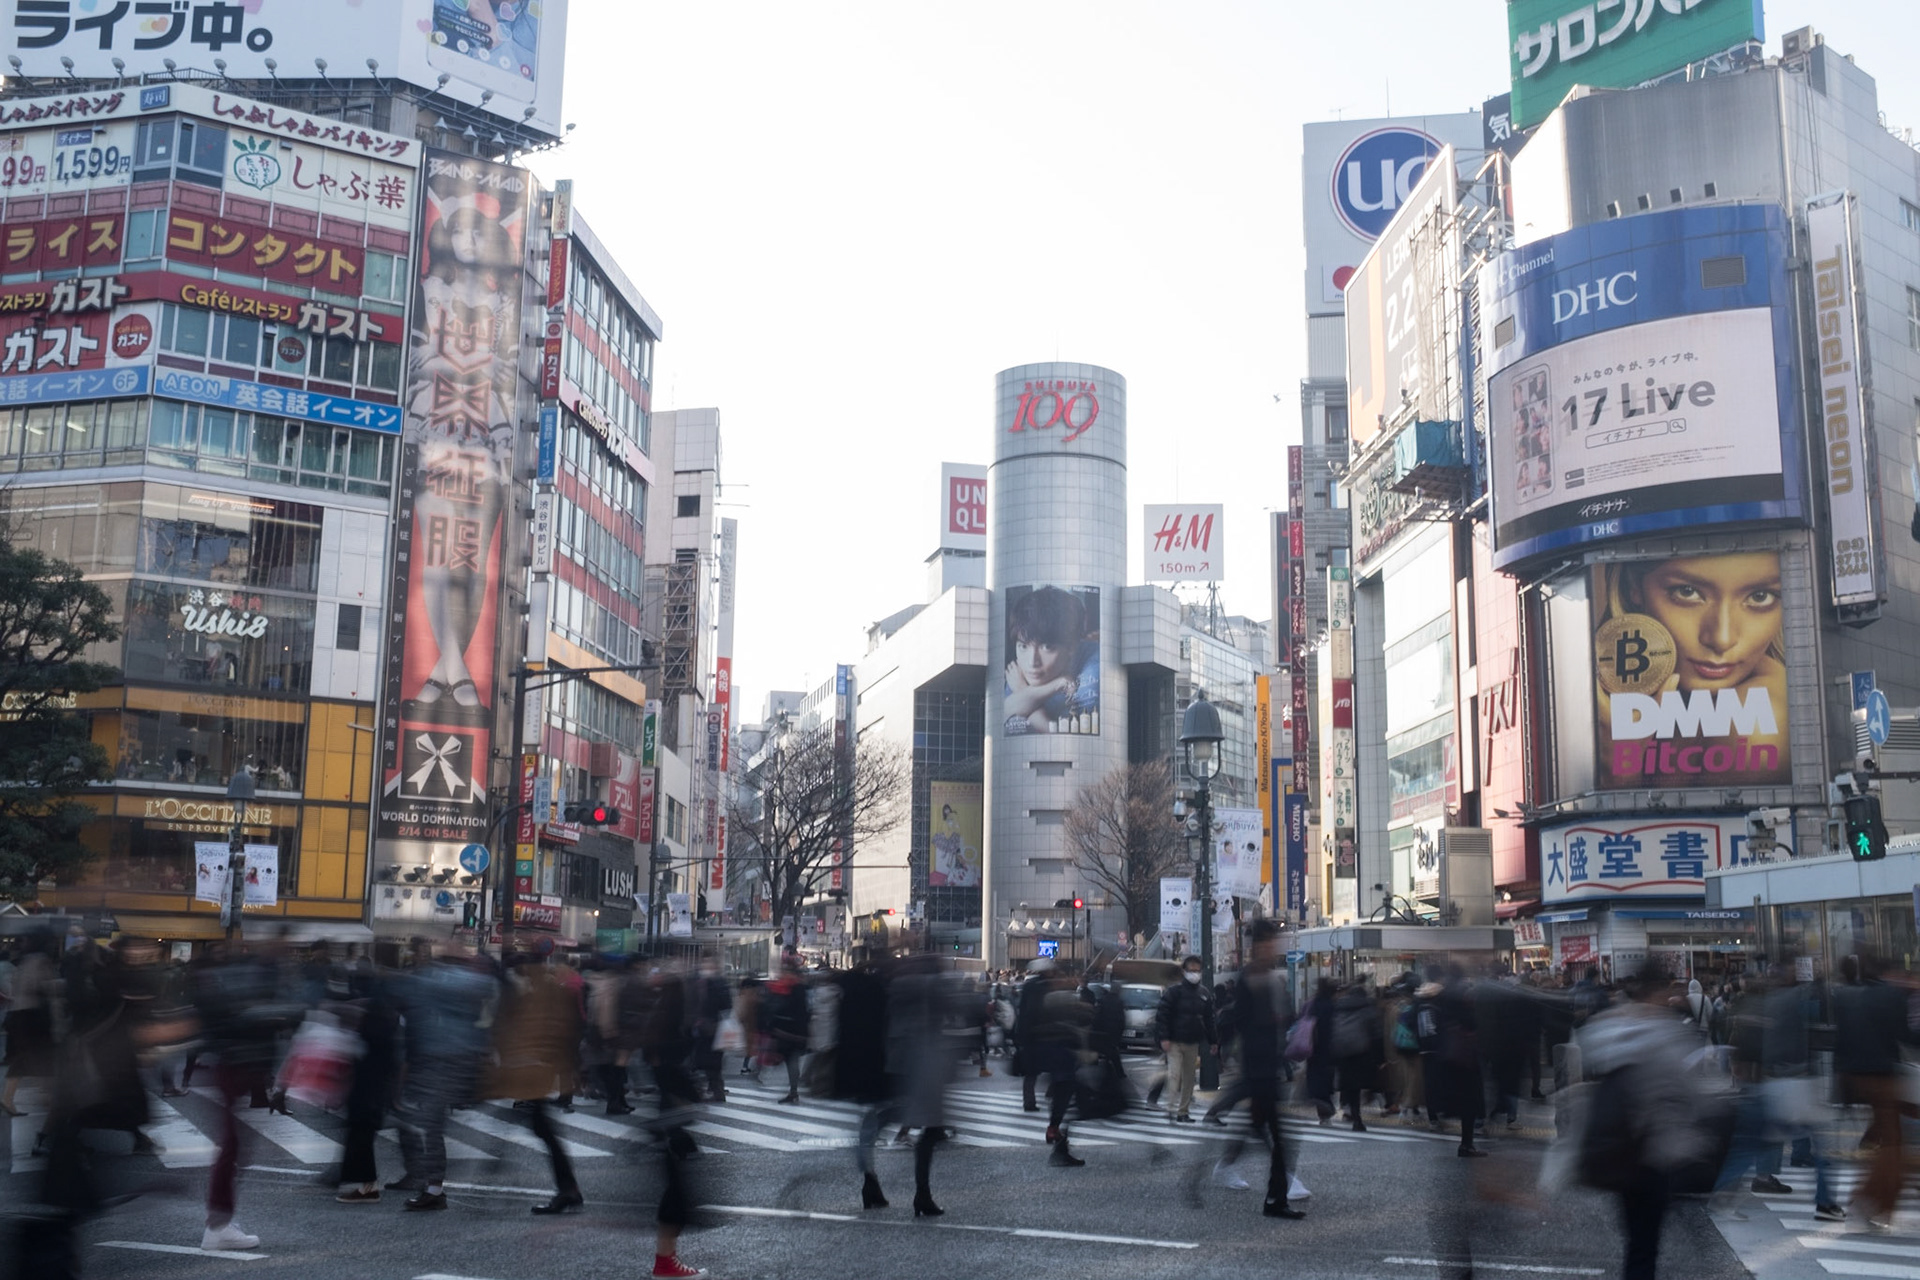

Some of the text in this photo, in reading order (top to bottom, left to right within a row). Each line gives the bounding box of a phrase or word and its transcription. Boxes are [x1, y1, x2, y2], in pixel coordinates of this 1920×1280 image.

[14, 0, 273, 52] ライブ中。
[1514, 0, 1702, 78] サロン
[143, 90, 167, 105] 寿司
[60, 133, 91, 145] ディナー
[213, 94, 411, 158] しゃぶしゃぶバイキング
[292, 154, 407, 211] しゃぶ葉
[428, 157, 526, 194] BAND-MAID
[168, 216, 358, 284] コンタクト
[1508, 247, 1555, 282] Channel
[49, 276, 128, 314] ガスト
[1551, 269, 1639, 326] DHC
[117, 332, 149, 348] ガスト
[297, 302, 384, 343] ガスト
[1, 326, 99, 373] ガスト
[115, 373, 136, 394] 6F
[546, 355, 558, 391] ガスト
[1025, 380, 1097, 392] SHIBUYA
[1572, 351, 1700, 385] みんなの今が、ライブ中。
[1815, 244, 1854, 496] Taisei neon
[163, 373, 399, 428] AEON 英会話イーオン
[1007, 389, 1100, 443] 109
[1561, 376, 1717, 432] 17 Live
[1602, 426, 1647, 443] イチナナ
[536, 500, 549, 567] 渋谷駅前ビル
[1154, 513, 1215, 553] H&M
[1592, 522, 1619, 537] DHC
[1159, 562, 1197, 574] 150m
[180, 604, 269, 639] Ushi8
[1334, 698, 1351, 709] JTB
[1611, 687, 1779, 741] DMM
[645, 725, 654, 750] レイク
[1611, 738, 1779, 777] Bitcoin
[615, 786, 634, 811] アコム
[641, 802, 651, 829] アコム
[381, 811, 486, 828] WORLD DOMINATION
[398, 826, 468, 840] 2/14 ON SALE
[1292, 804, 1301, 842] MIZUHO
[604, 868, 634, 899] LUSH
[1685, 911, 1740, 919] TAISEIDO
